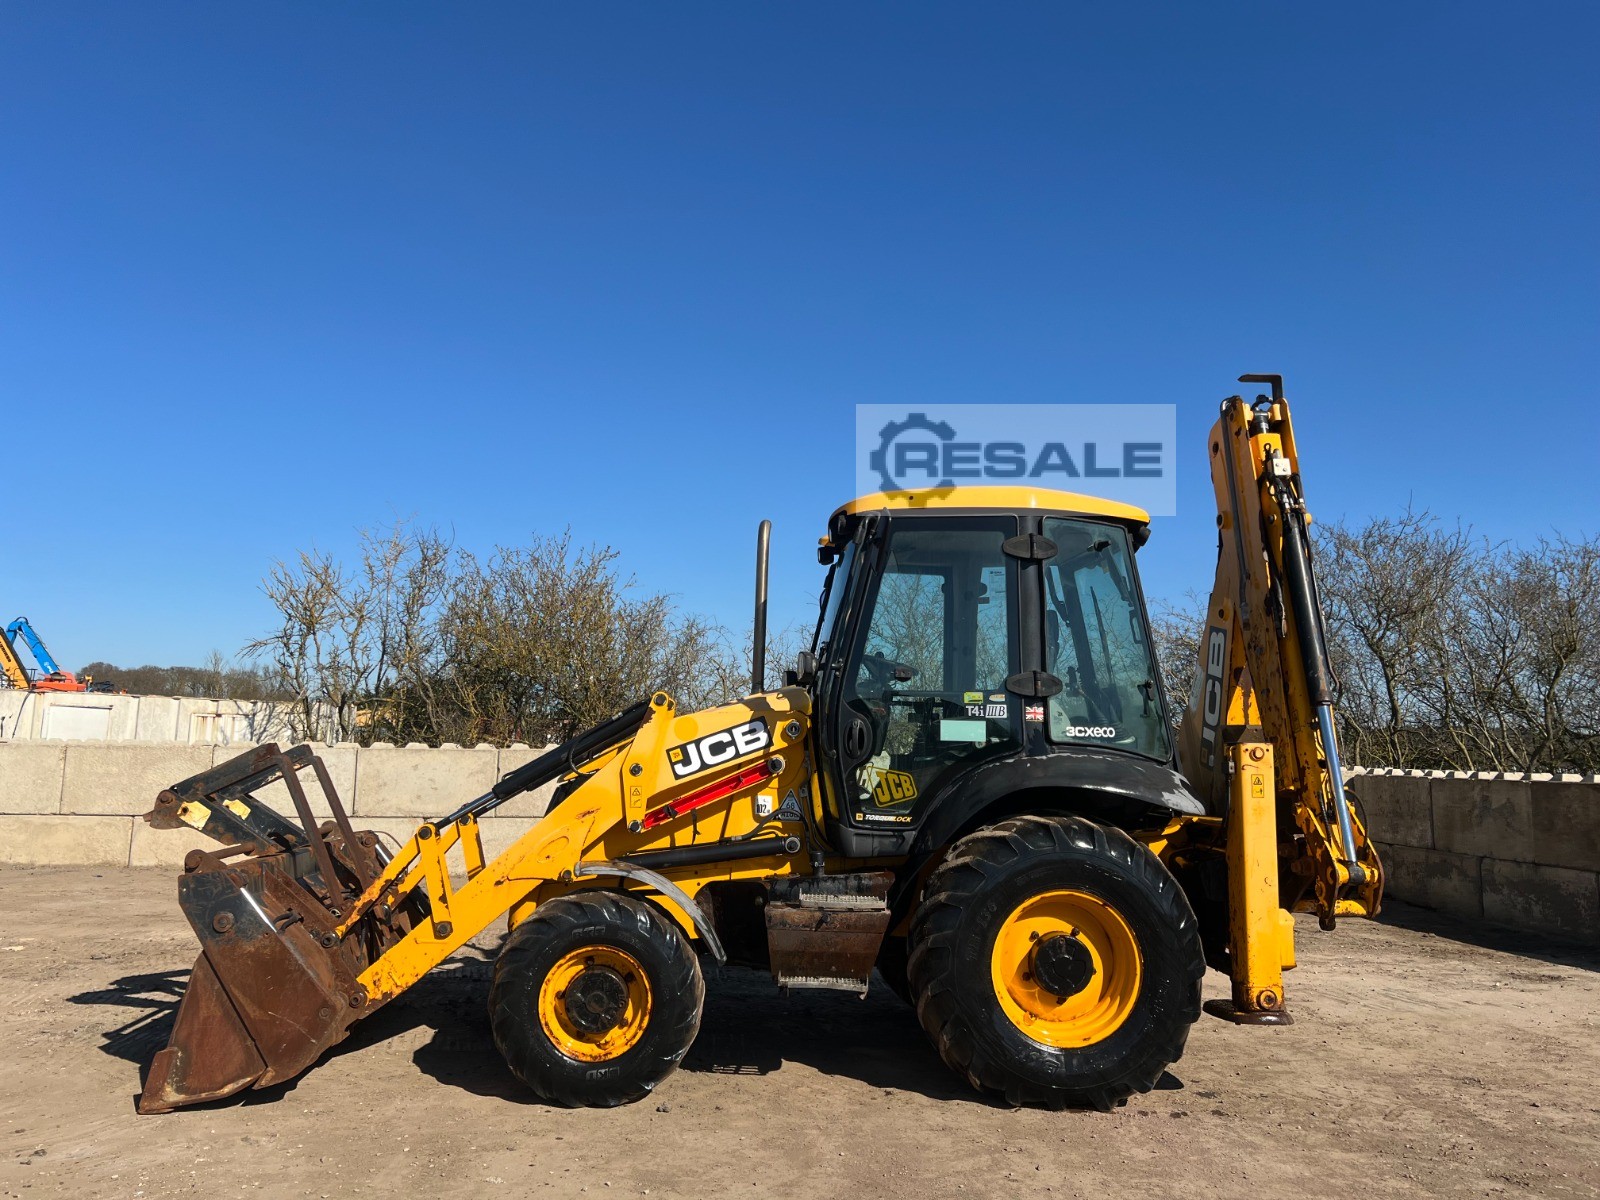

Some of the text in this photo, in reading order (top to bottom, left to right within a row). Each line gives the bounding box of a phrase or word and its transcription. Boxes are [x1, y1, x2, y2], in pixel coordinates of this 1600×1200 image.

[965, 705, 985, 717] T4i
[1203, 631, 1225, 767] JCB
[673, 720, 769, 776] JCB
[876, 771, 914, 803] JCB
